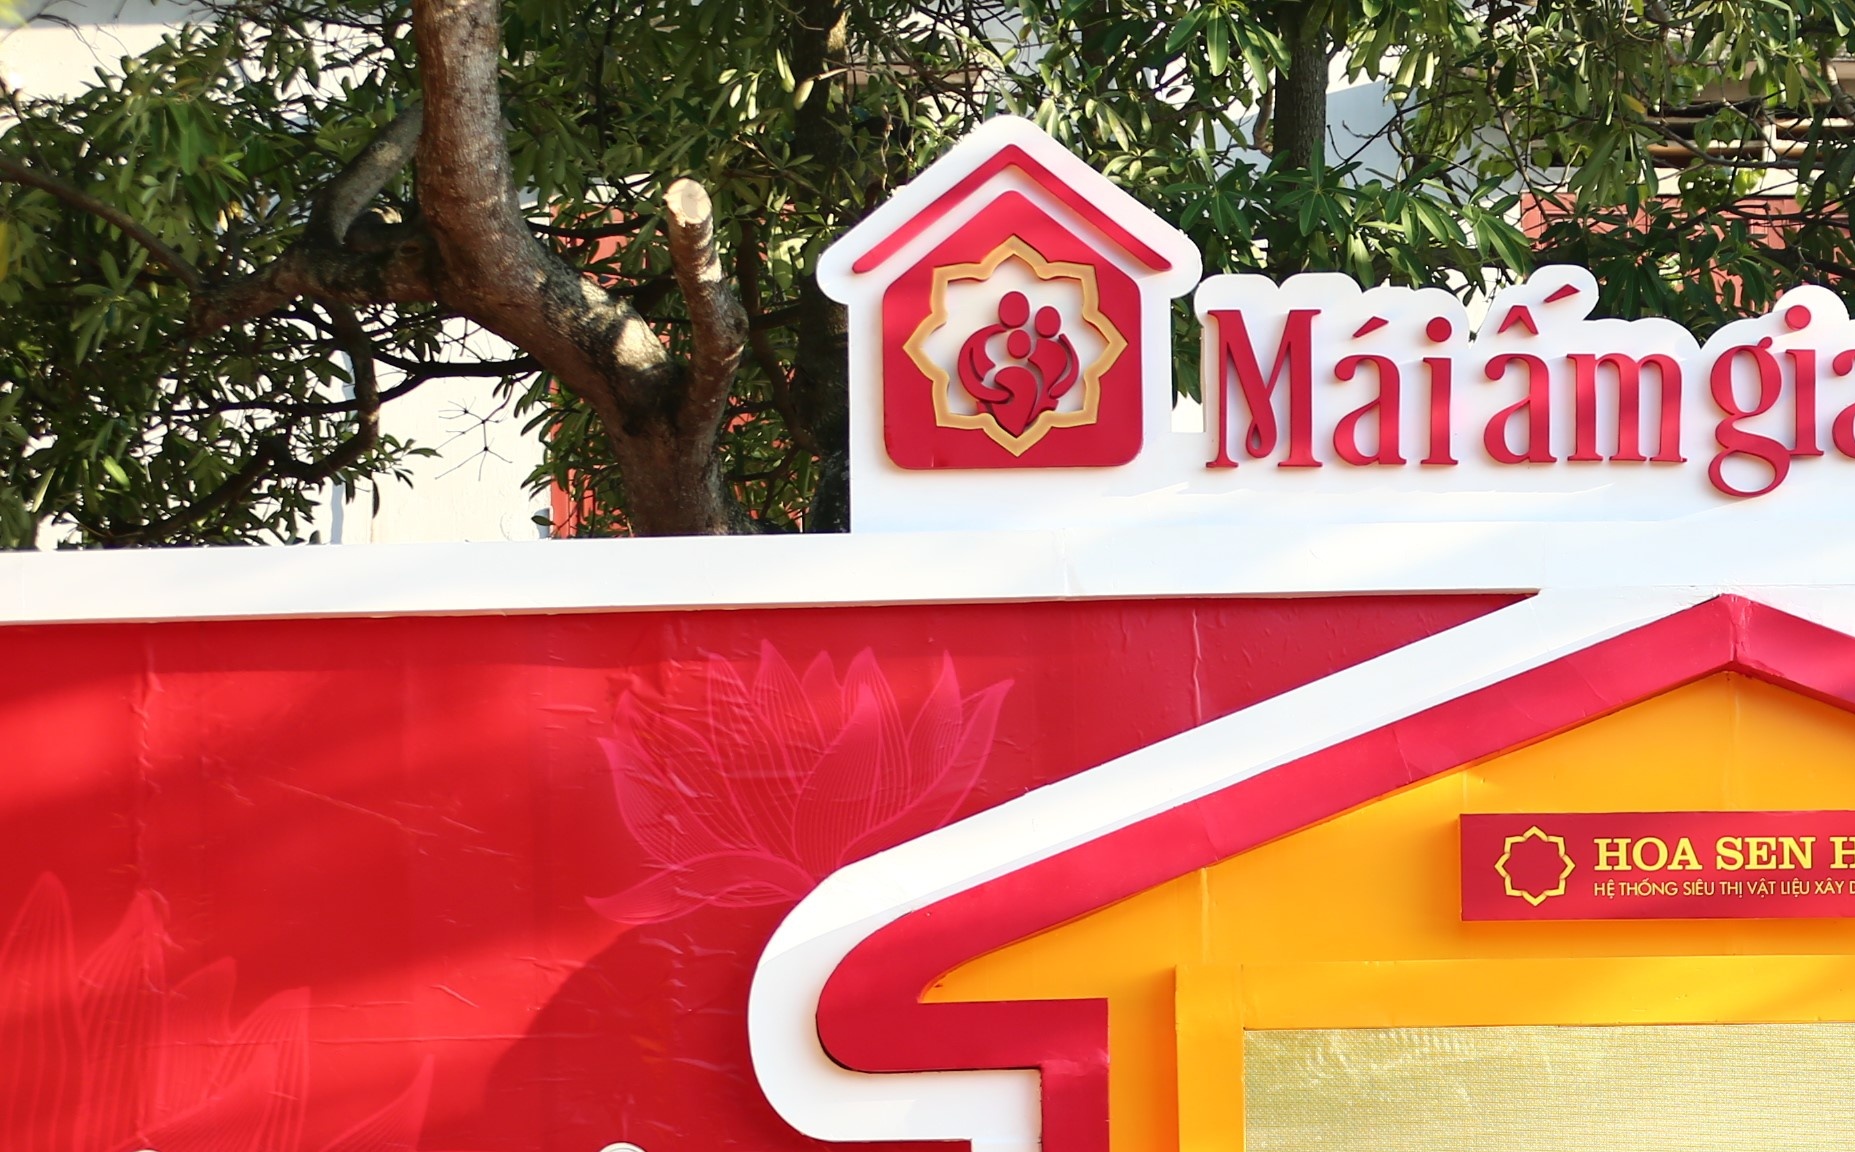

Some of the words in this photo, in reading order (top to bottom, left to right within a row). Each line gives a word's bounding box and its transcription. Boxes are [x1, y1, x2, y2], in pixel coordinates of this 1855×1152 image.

[1205, 307, 1458, 469] Mái
[1483, 283, 1689, 465] ấm
[1593, 836, 1704, 872] HOA
[1715, 835, 1817, 871] SEN
[1593, 879, 1615, 899] HỆ
[1618, 877, 1679, 896] THỐNG
[1682, 878, 1715, 896] SIÊU
[1719, 880, 1743, 898] THỊ
[1746, 878, 1776, 898] VẬT
[1780, 877, 1811, 898] LIỆU
[1813, 877, 1846, 895] XÂY
